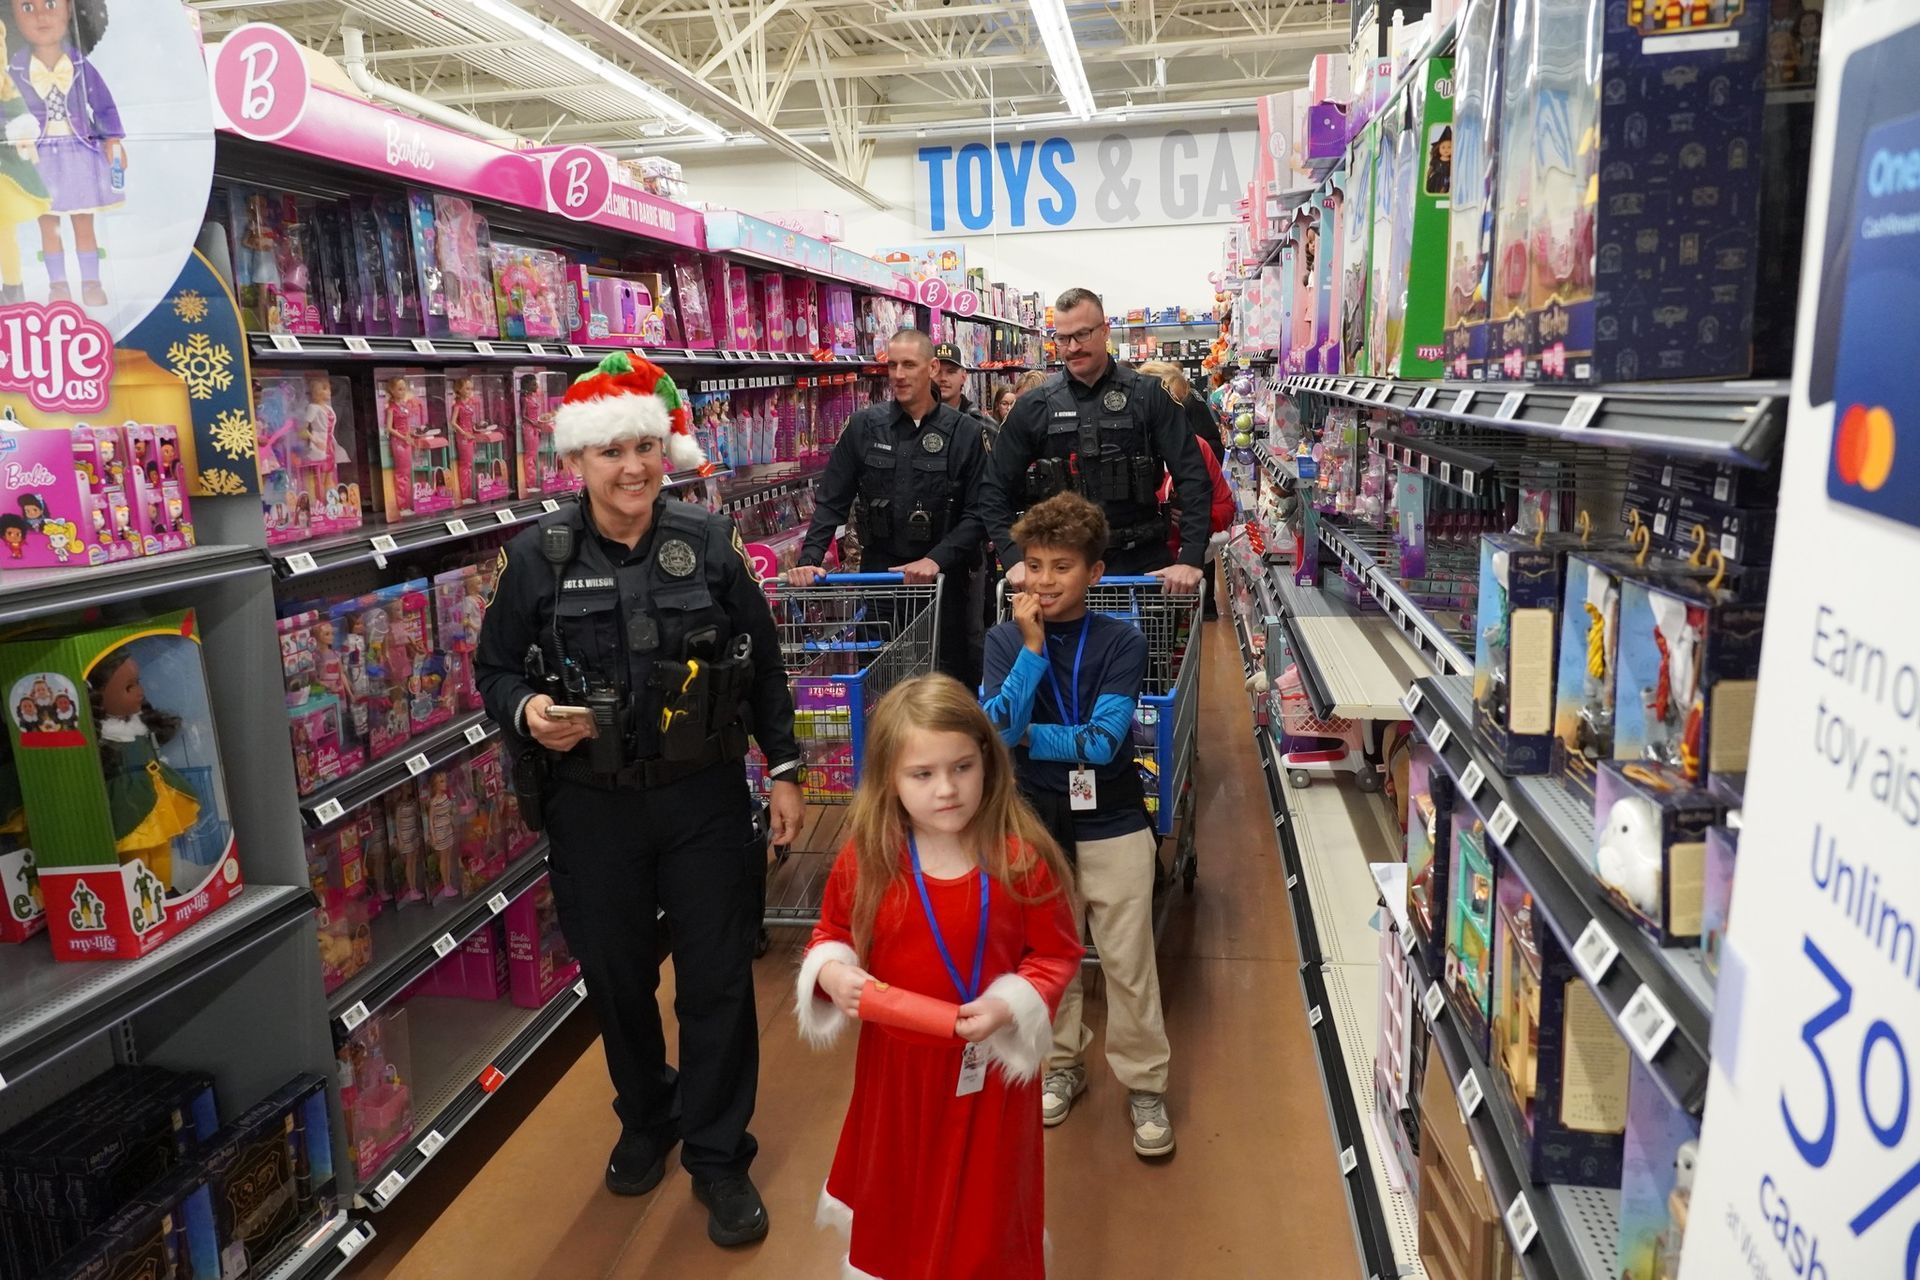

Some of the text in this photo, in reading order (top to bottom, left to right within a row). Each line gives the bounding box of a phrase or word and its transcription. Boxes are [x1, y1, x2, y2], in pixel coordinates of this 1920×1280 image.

[240, 41, 278, 120] B
[384, 119, 435, 170] Barbie
[566, 157, 592, 207] B
[918, 127, 1259, 231] TOYS & GA
[630, 198, 638, 222] TO
[639, 201, 658, 227] BARBIE
[657, 207, 676, 232] WORLD
[65, 379, 98, 400] as
[5, 461, 57, 490] Barbie
[563, 577, 614, 589] SGT. S. WILSON
[1812, 604, 1920, 729] Earn o
[1814, 697, 1871, 792] toy
[1810, 823, 1920, 991] Unlim
